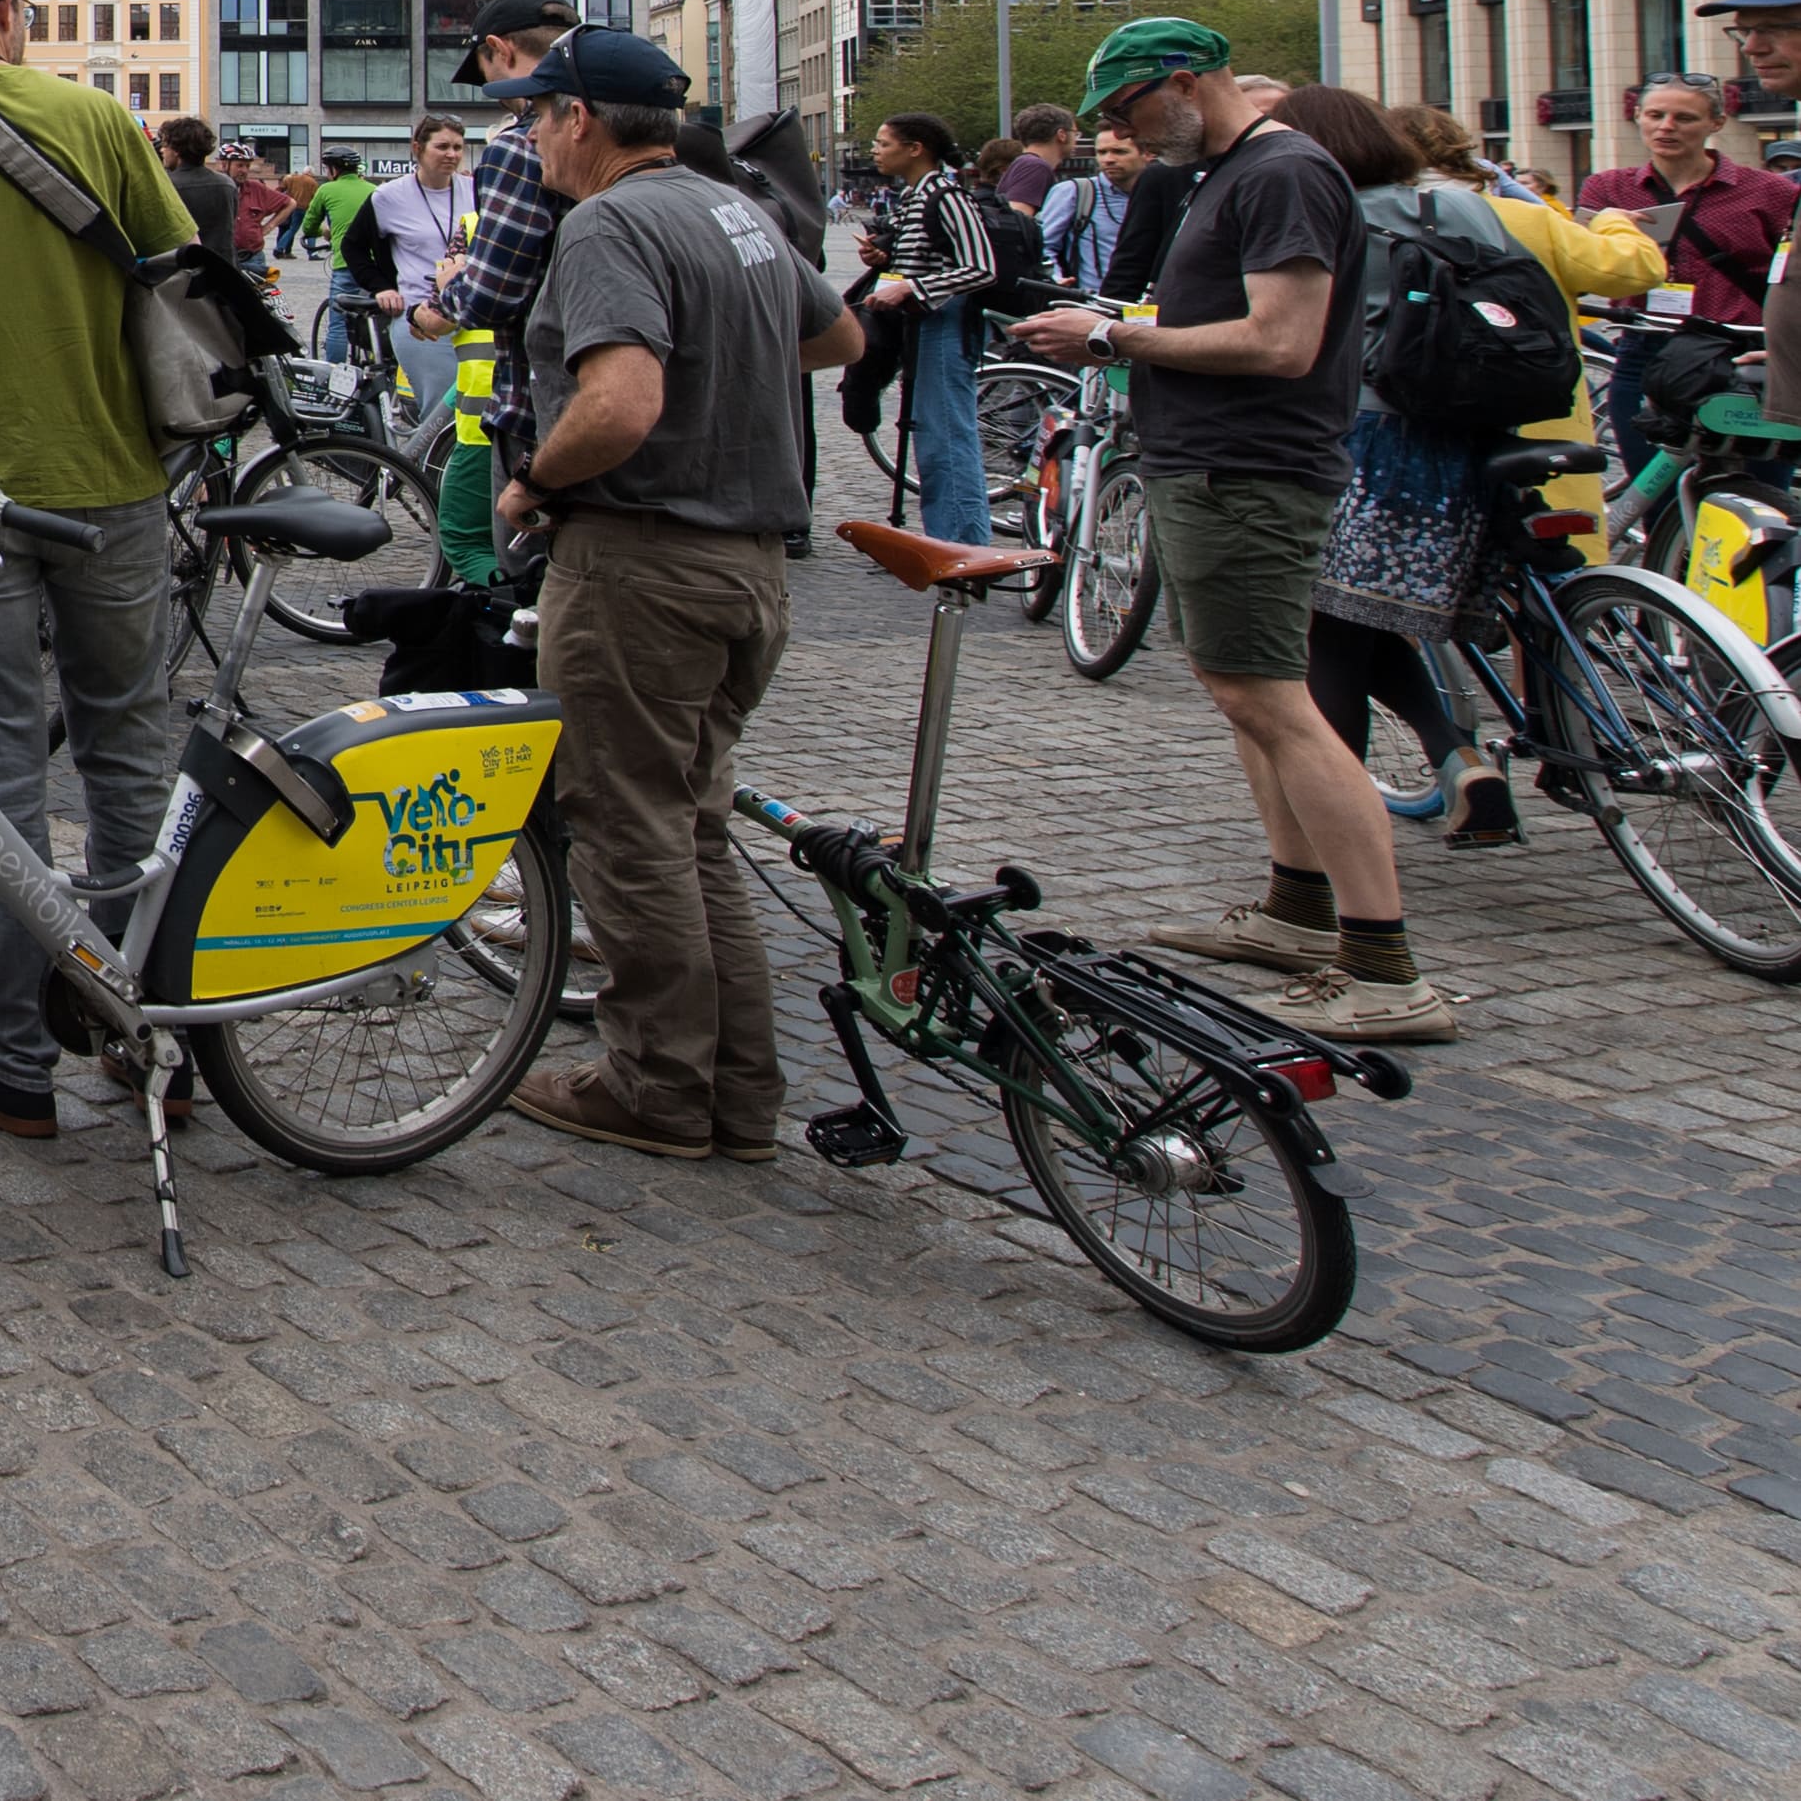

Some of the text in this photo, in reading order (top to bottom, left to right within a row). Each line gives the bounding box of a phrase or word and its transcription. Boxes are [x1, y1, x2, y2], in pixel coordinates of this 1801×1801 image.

[354, 37, 378, 47] ZARA
[377, 160, 418, 175] Mark
[168, 791, 204, 856] 300396
[386, 879, 449, 894] LEIPZIG
